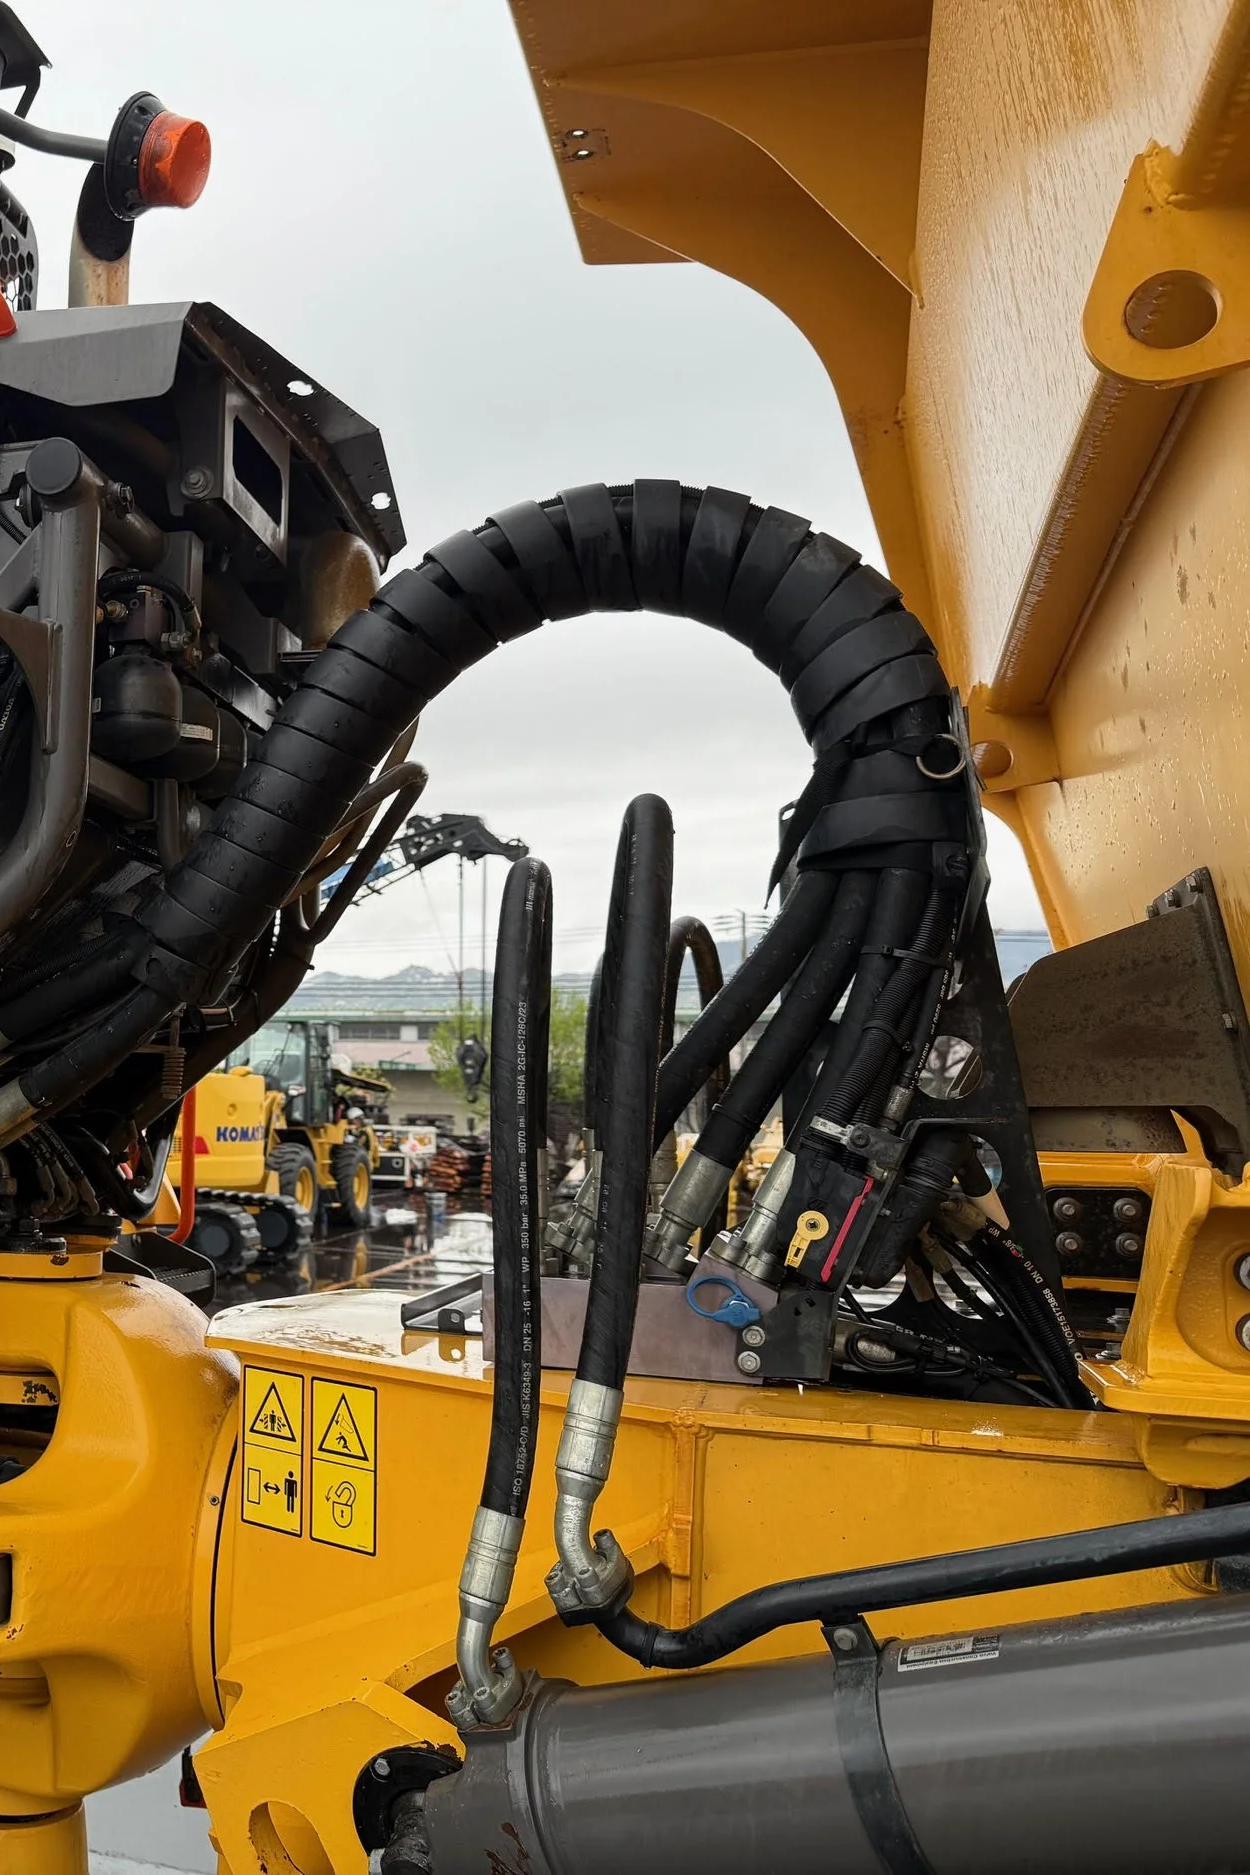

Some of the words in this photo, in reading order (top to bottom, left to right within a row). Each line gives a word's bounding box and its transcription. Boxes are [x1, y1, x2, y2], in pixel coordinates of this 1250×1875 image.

[517, 1074, 526, 1105] MSHA
[519, 1161, 527, 1183] MPa
[519, 1185, 528, 1205] 35.0
[521, 1212, 529, 1229] bar
[521, 1231, 529, 1249] 350
[521, 1256, 530, 1273] WP
[1023, 1260, 1034, 1271] 10
[1030, 1270, 1044, 1284] DN
[523, 1300, 531, 1316] -16
[1042, 1288, 1075, 1345] VOE15173858
[523, 1322, 532, 1335] 25
[523, 1337, 532, 1352] DN
[521, 1403, 531, 1419] JIS
[512, 1477, 523, 1496] ISO
